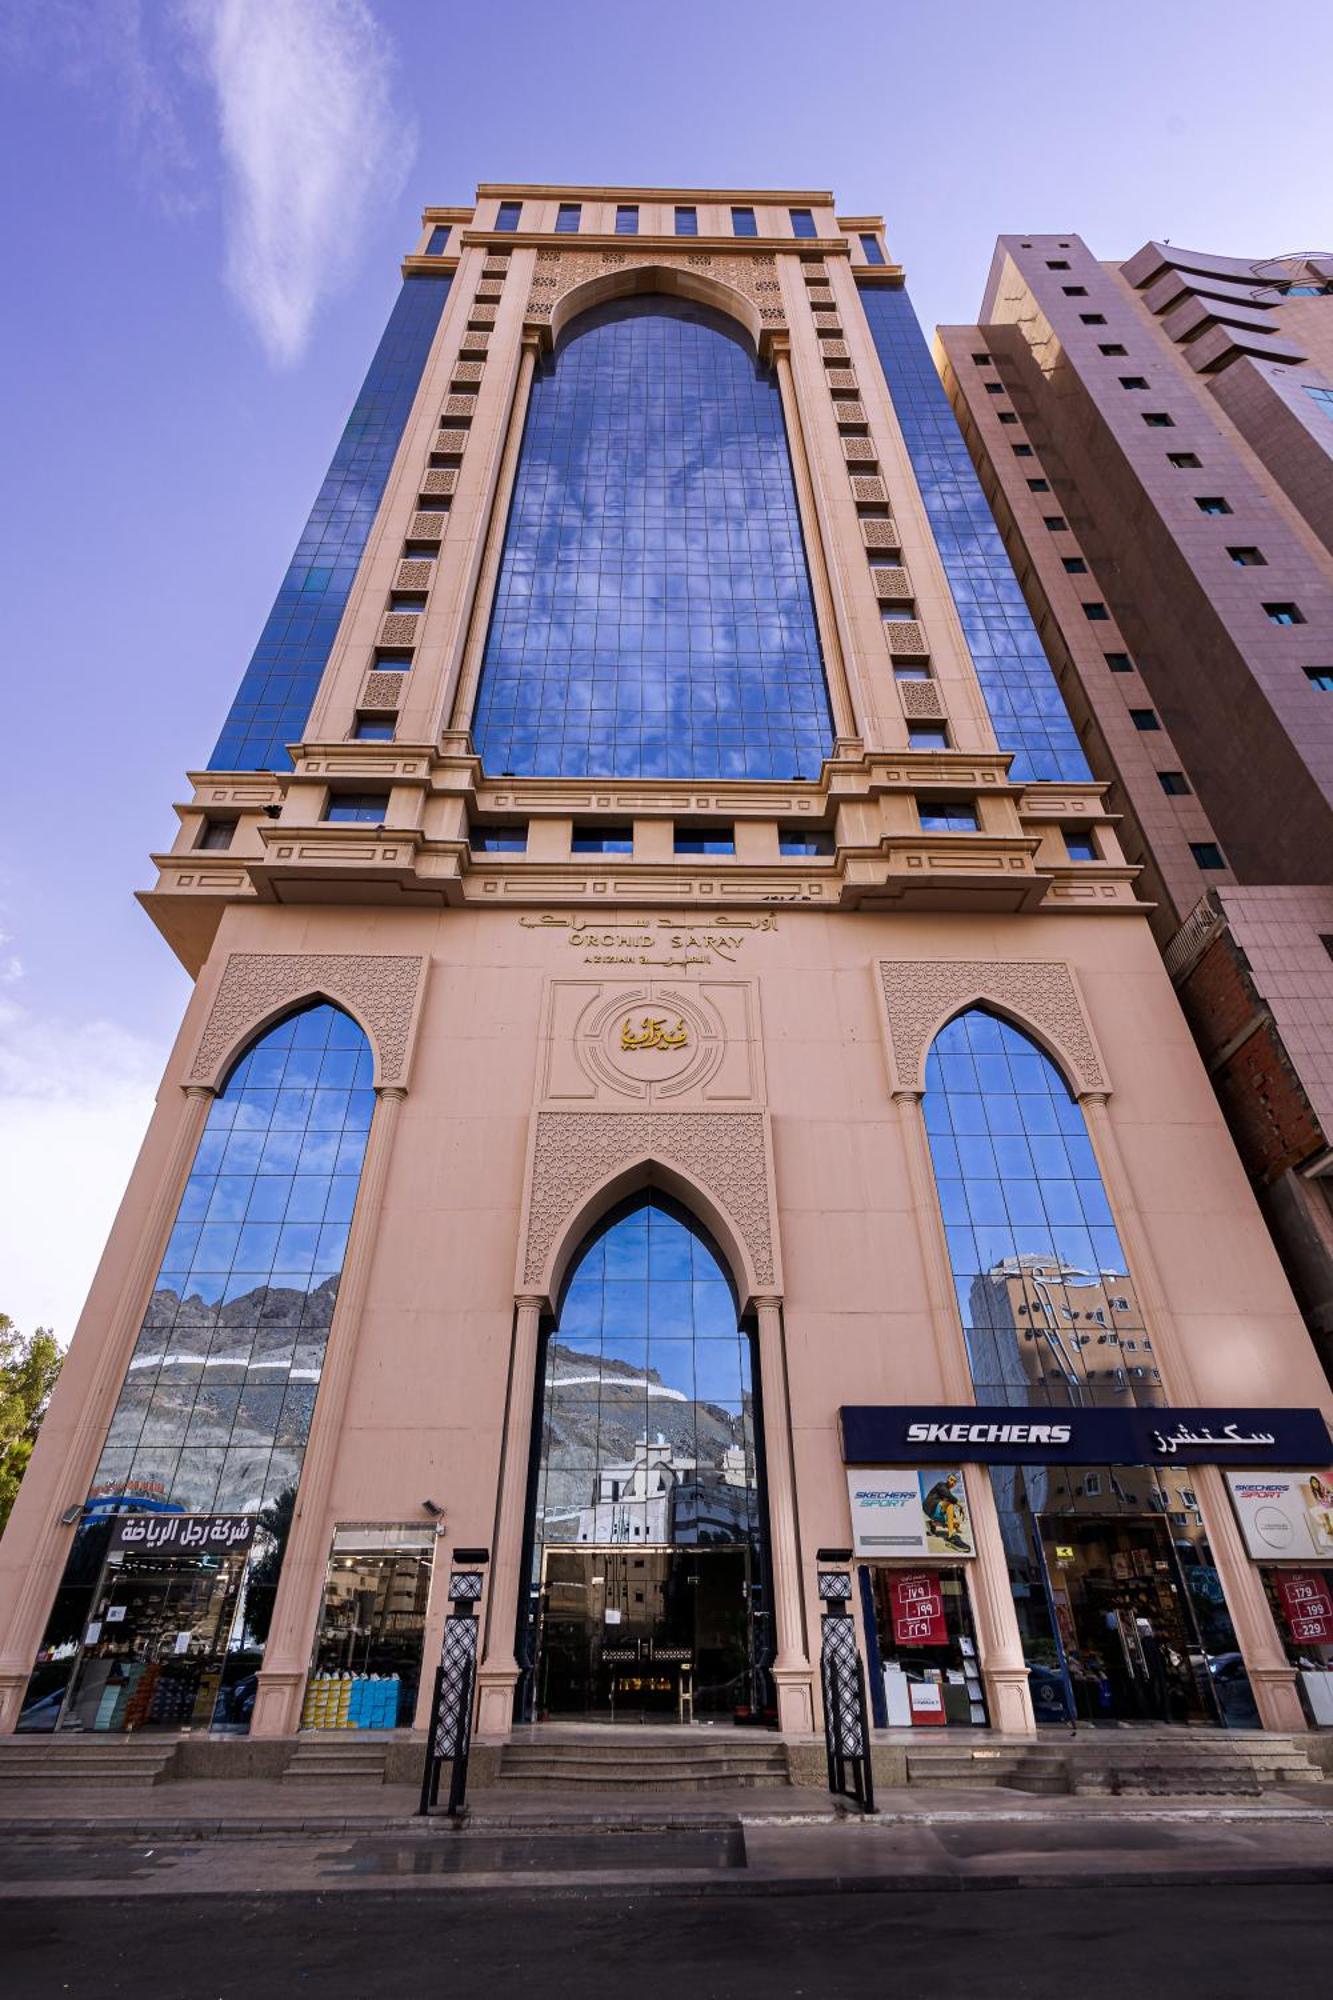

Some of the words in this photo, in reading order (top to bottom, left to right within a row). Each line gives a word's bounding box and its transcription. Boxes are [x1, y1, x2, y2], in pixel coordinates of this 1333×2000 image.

[569, 934, 655, 948] ORCHID
[671, 936, 745, 962] SARAY
[907, 1424, 1071, 1443] SKECHERS
[1154, 1424, 1275, 1453] سكتشرز
[855, 1491, 917, 1500] SKECHERS
[1234, 1484, 1290, 1492] SKECHERS
[1240, 1491, 1283, 1499] SPORT
[860, 1500, 908, 1508] SPORT
[121, 1519, 179, 1547] الرياضة
[180, 1519, 208, 1547] رجل
[210, 1518, 249, 1546] شركة
